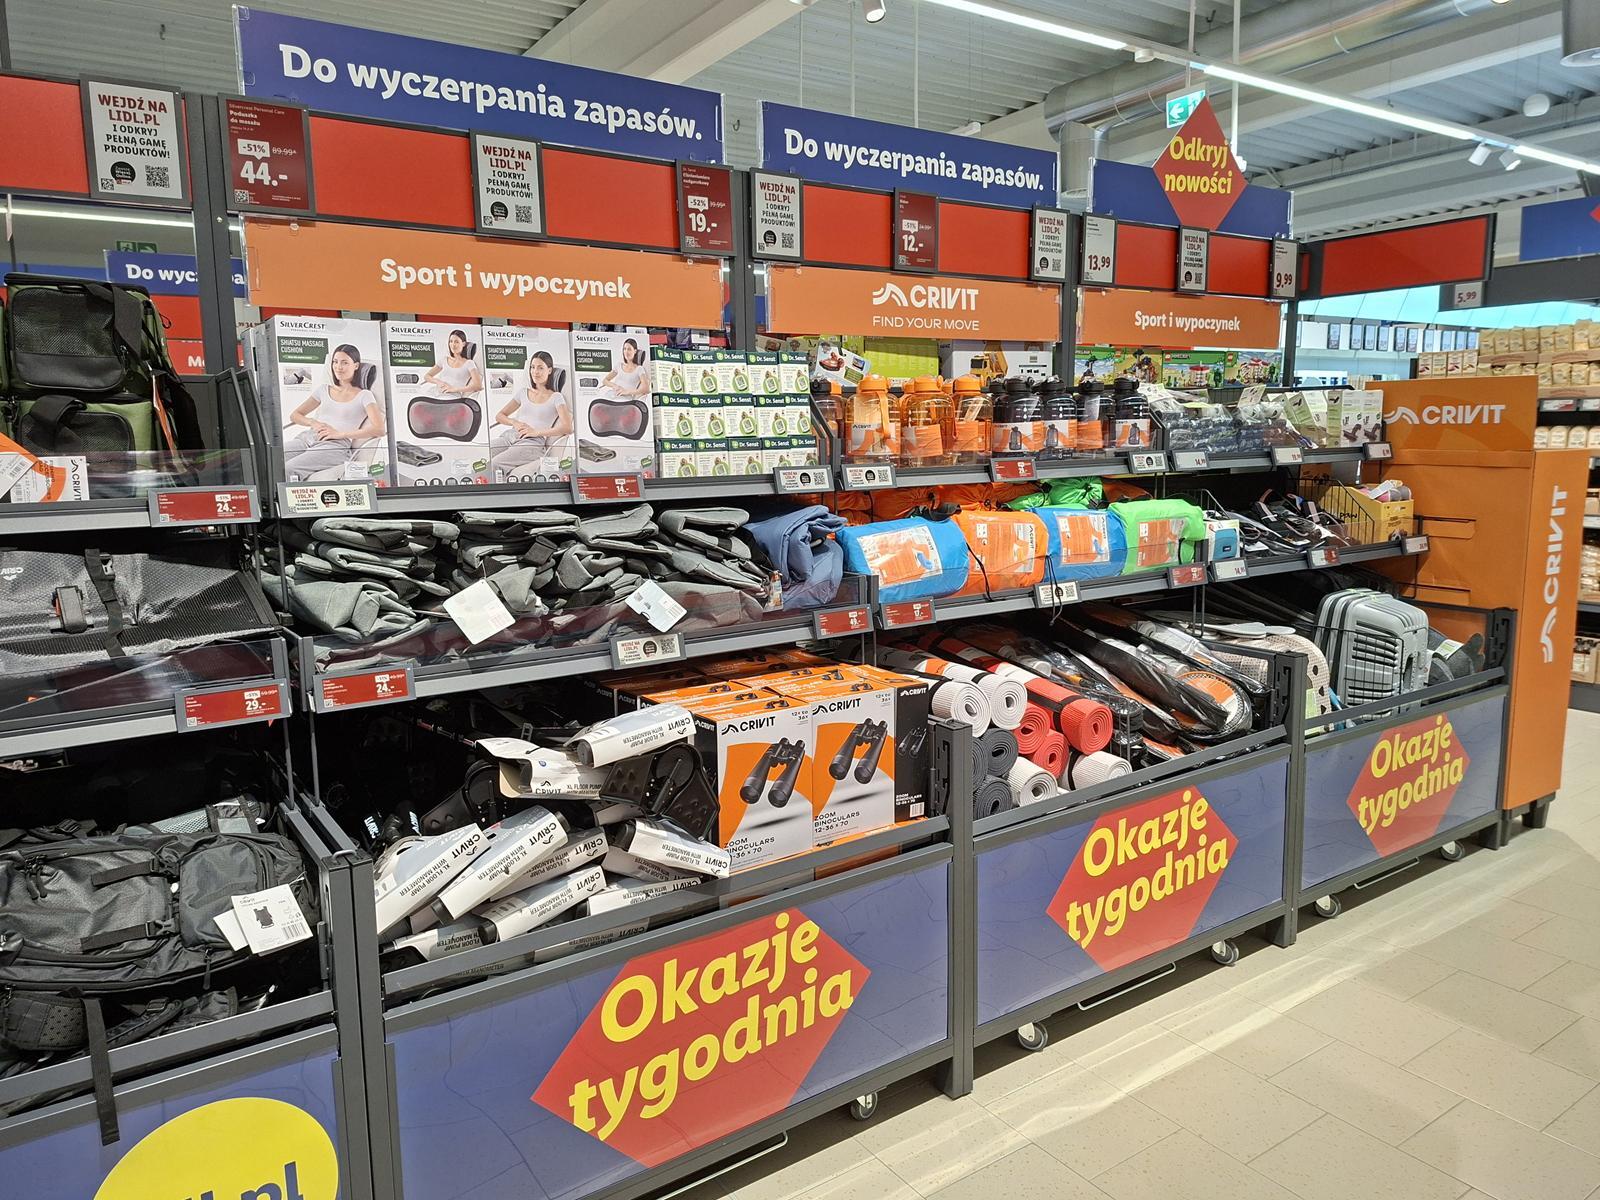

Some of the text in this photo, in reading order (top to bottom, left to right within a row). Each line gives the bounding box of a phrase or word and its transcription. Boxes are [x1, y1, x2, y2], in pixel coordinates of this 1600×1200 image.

[279, 43, 703, 141] Do wyczerpania zapasów.
[98, 94, 168, 114] WEJDŹ NA
[108, 109, 160, 126] LIDL.PL
[113, 124, 158, 137] I ODKRYJ
[106, 133, 167, 150] PEŁNĄ GAMĘ
[242, 143, 266, 154] -51%
[103, 144, 170, 159] PRODUKTÓW!
[482, 144, 532, 161] WEJDŹ NA
[784, 128, 1044, 191] Do wyczerpania zapasów.
[1169, 135, 1229, 169] Odkryj
[490, 157, 527, 172] LIDL.PL
[240, 160, 288, 187] 44.-
[497, 170, 525, 181] ODKRYJ
[1164, 170, 1233, 194] nowości
[486, 187, 533, 199] PRODUKTÓW!
[487, 178, 530, 191] PEŁNĄ GAMĘ
[759, 181, 796, 195] WEJDŹ NA
[764, 192, 791, 204] LIDL.PL
[769, 203, 790, 212] ODKRYJ
[688, 212, 718, 233] 19.-
[902, 234, 924, 252] 12.-
[125, 263, 154, 279] Do
[1087, 254, 1111, 271] 13.99
[380, 258, 632, 299] Sport i wypoczynek
[1276, 272, 1293, 288] 9.99
[910, 285, 979, 310] CRIVIT
[1457, 290, 1477, 304] 5.99
[872, 316, 980, 331] FIND YOUR MOVE
[1134, 310, 1240, 332] Sport i wypoczynek
[280, 338, 325, 348] SHIATSU MASSAGE
[280, 346, 304, 354] CUSHION
[391, 343, 431, 352] SHIATSU MASSAGE
[505, 347, 524, 355] MASSAGE
[391, 350, 413, 358] CUSHION
[1422, 404, 1506, 425] CRIVIT
[216, 502, 237, 513] 24.-
[1543, 485, 1568, 605] CRIVIT
[909, 687, 927, 695] CRIVIT
[245, 699, 267, 711] 29.-
[828, 698, 862, 713] CRIVIT
[668, 717, 691, 731] CRIVIT
[740, 715, 776, 733] CRIVIT
[1370, 714, 1453, 778] Okazje
[1358, 751, 1464, 836] tygodnia
[814, 811, 836, 821] ZOOM
[814, 811, 861, 827] BINOCULARS
[529, 822, 557, 847] CRIVIT
[814, 824, 834, 833] 12-36
[1083, 790, 1208, 877] Okazje
[452, 833, 481, 859] CRIVIT
[574, 838, 604, 856] CRIVIT
[751, 846, 762, 854] 70
[705, 856, 728, 869] CRIVIT
[399, 858, 447, 897] WITH MANOMETER
[427, 867, 444, 884] FLOOR
[576, 871, 601, 891] CRIVIT
[410, 879, 429, 897] PUMP
[1066, 834, 1229, 949] tygodnia
[600, 912, 820, 1043] Okazje
[568, 967, 854, 1141] tygodnia
